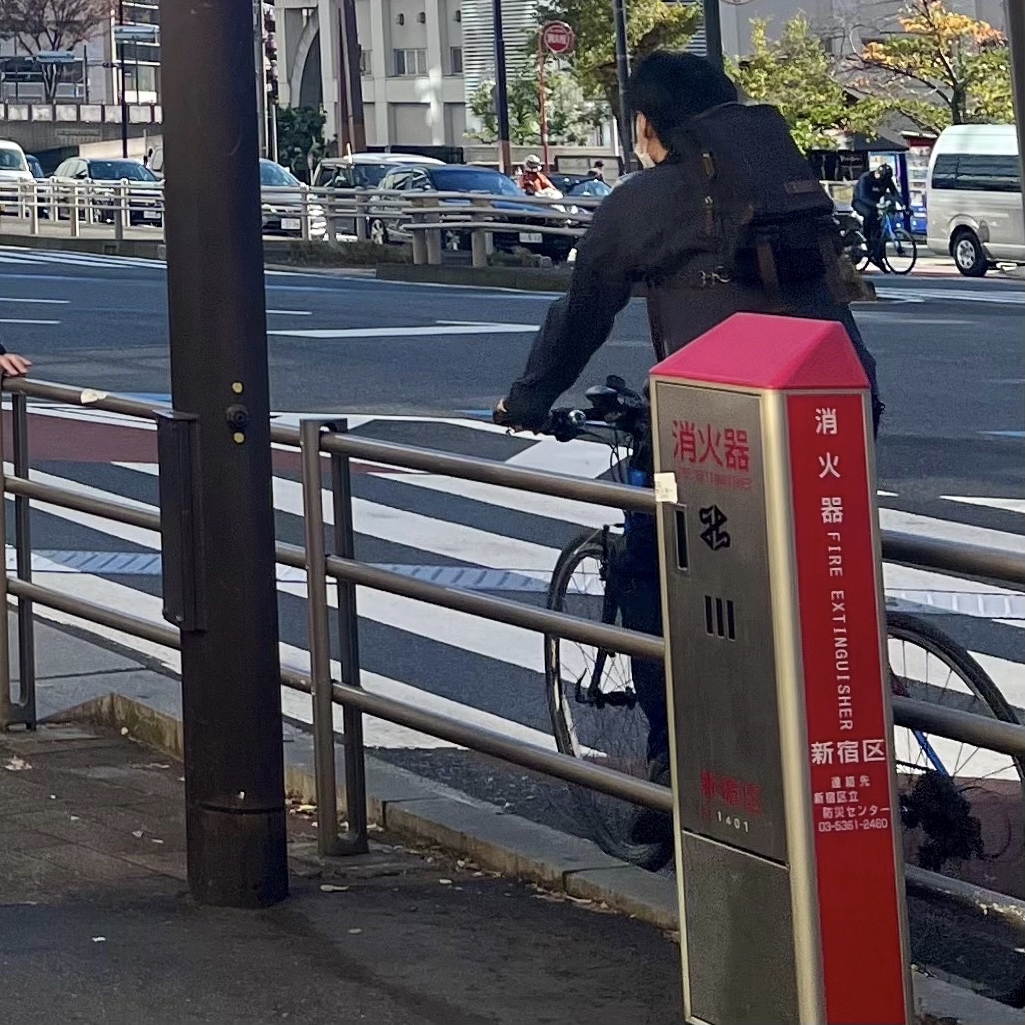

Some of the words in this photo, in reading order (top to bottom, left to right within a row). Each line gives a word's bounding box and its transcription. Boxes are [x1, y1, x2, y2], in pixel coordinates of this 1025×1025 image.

[672, 420, 750, 472] 消火器
[815, 408, 844, 523] 消火器
[827, 532, 843, 576] FIRE
[831, 590, 853, 731] EXTINGUISHER
[811, 738, 886, 765] 新宿区
[814, 791, 859, 804] 新宿区立
[823, 805, 890, 819] 防災センター
[718, 811, 749, 832] 1401
